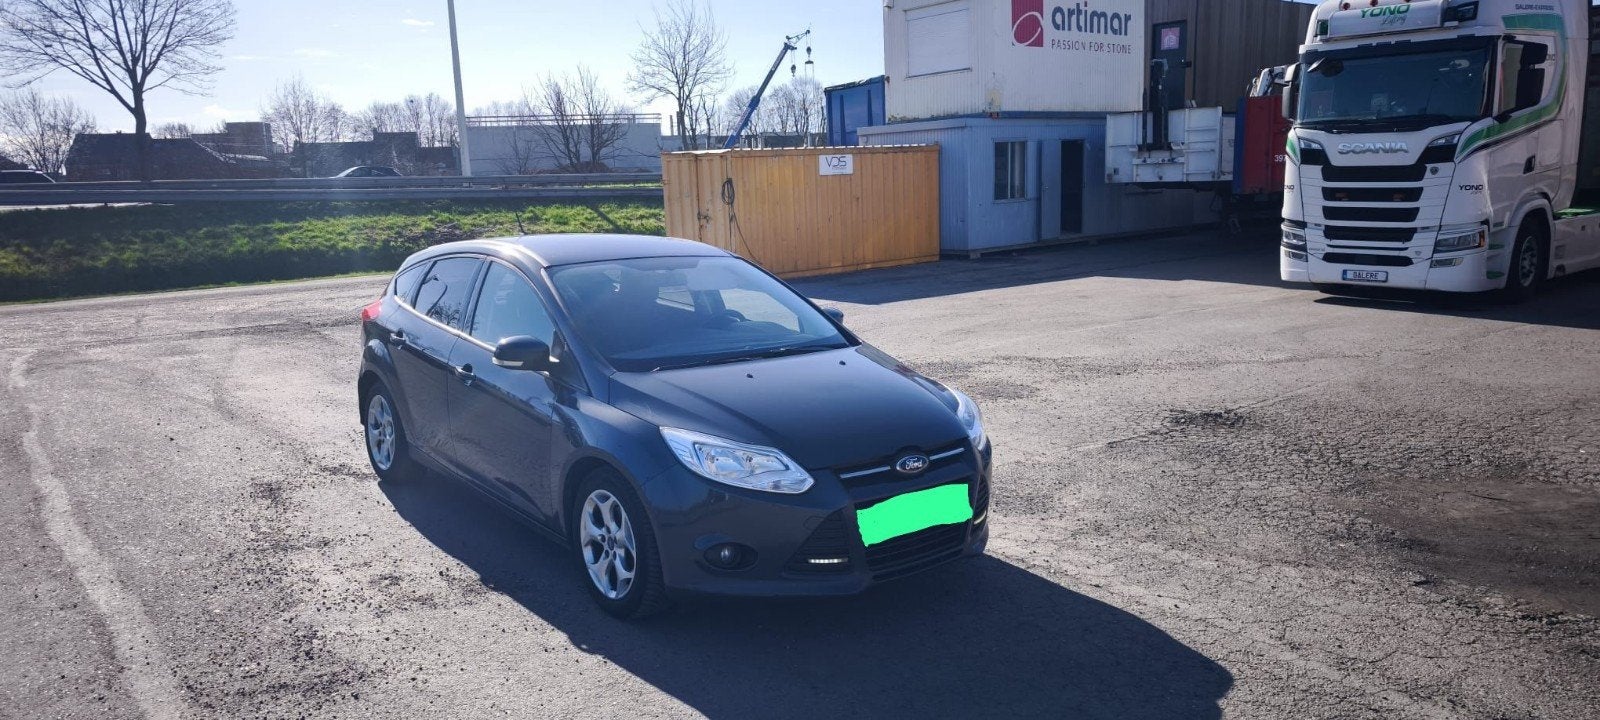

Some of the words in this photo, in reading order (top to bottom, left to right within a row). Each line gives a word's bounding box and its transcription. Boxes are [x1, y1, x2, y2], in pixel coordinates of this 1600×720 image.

[1360, 4, 1411, 18] YONO
[1051, 1, 1131, 36] artimar
[1051, 39, 1086, 51] PASSION
[1089, 41, 1104, 53] FOR
[1106, 43, 1132, 54] STONE
[1337, 142, 1409, 155] SCANIA
[825, 155, 847, 168] VDS
[905, 457, 923, 470] Ford
